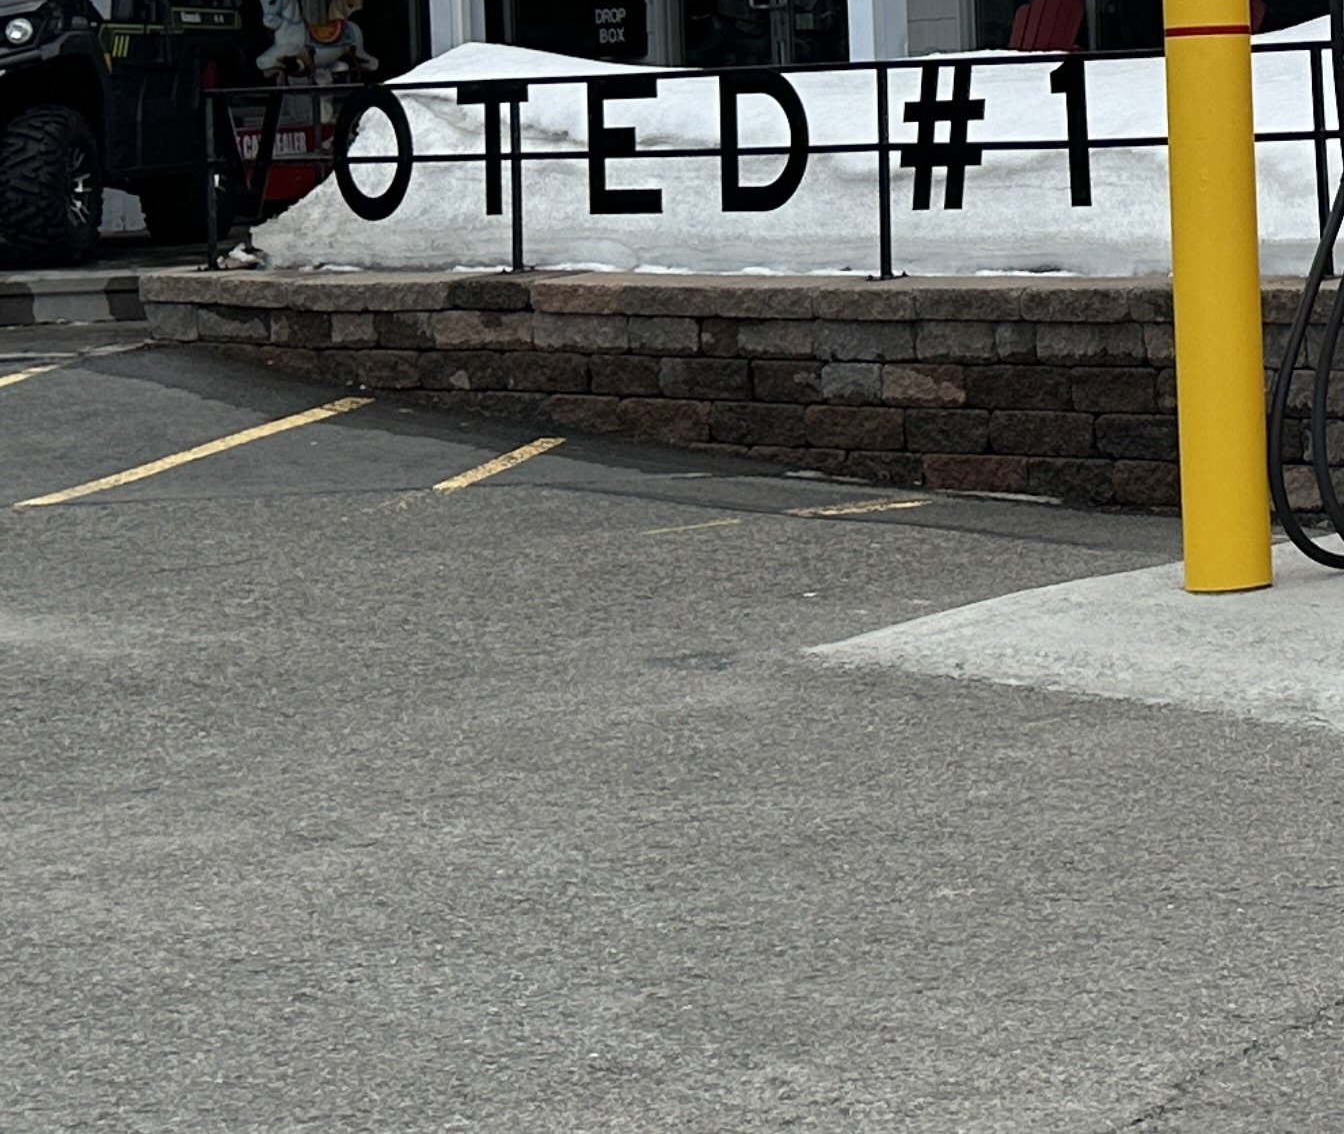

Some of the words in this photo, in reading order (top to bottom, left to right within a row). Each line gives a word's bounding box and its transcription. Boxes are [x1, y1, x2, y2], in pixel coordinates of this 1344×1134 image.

[595, 8, 626, 25] DROP
[599, 27, 626, 43] BOX
[222, 68, 810, 221] VOTED
[900, 57, 1093, 211] #1
